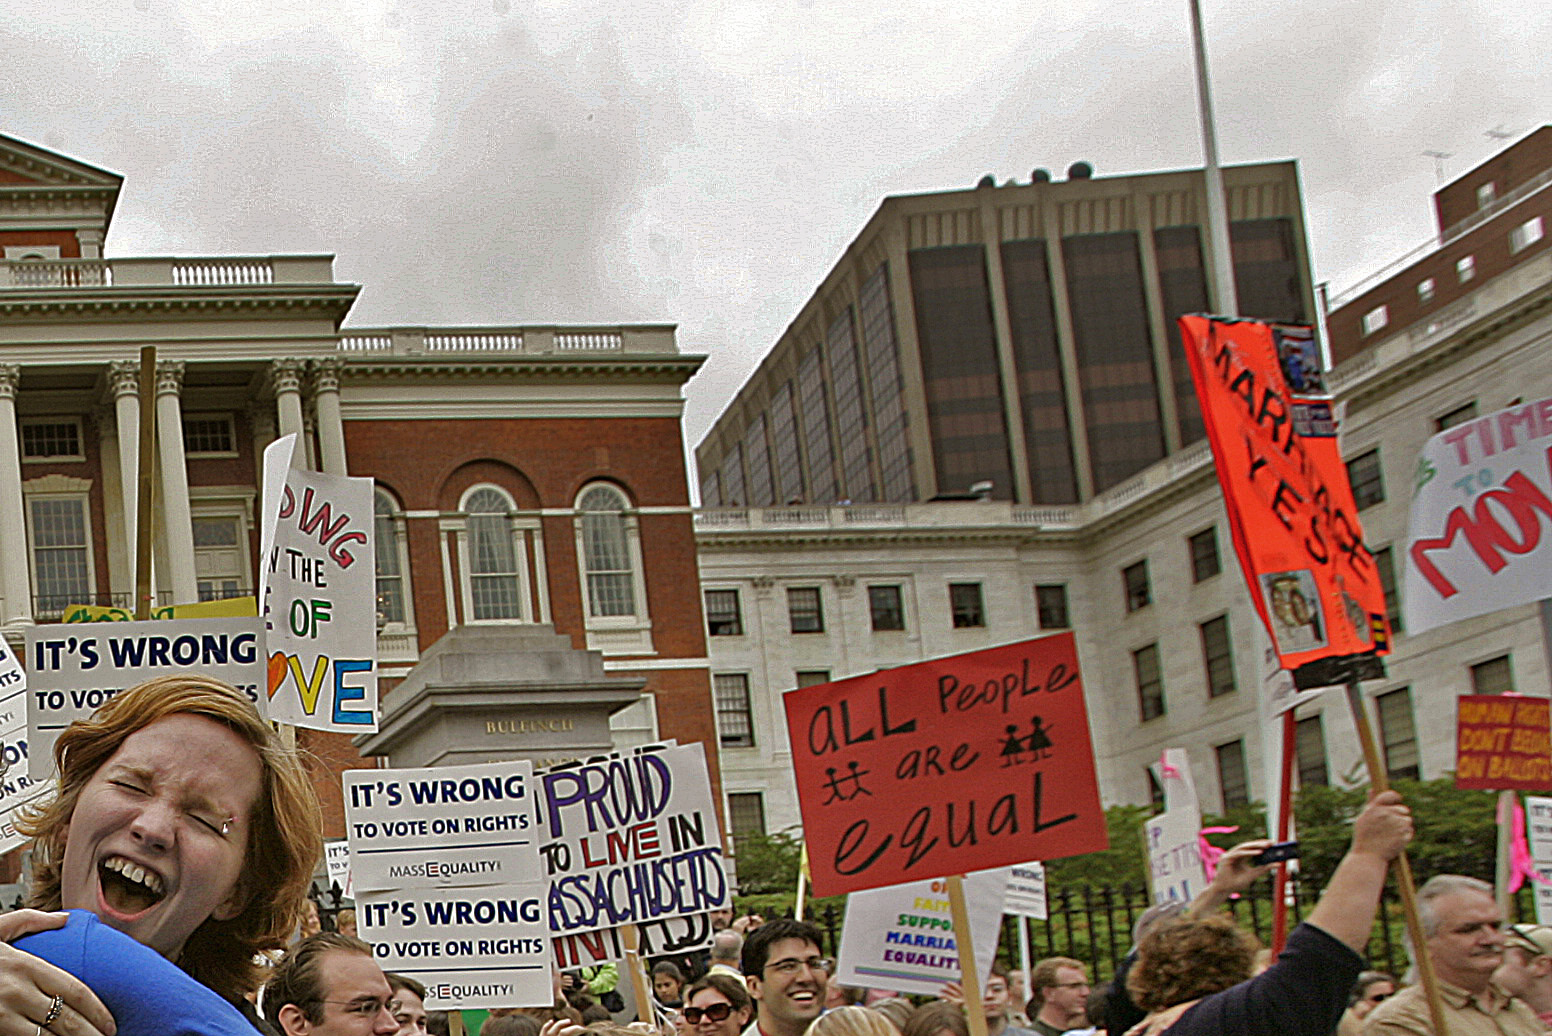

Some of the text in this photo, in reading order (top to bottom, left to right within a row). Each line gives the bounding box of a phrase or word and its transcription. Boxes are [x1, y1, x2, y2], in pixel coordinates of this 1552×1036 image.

[1453, 468, 1494, 497] TO
[286, 548, 327, 588] THE
[290, 599, 332, 639] OF
[36, 633, 256, 671] IT'S WRONG
[36, 692, 65, 710] TO
[485, 719, 574, 735] BULFINCH
[351, 775, 525, 808] IT'S WRONG
[543, 754, 671, 839] PROUD
[354, 814, 529, 838] TO VOTE ON RIGHTS
[539, 812, 704, 875] TO LIVE IN
[365, 899, 540, 927] IT'S WRONG
[897, 913, 953, 933] SUPPO
[395, 942, 440, 957] VOTE
[445, 941, 473, 956] ON
[479, 938, 544, 955] RIGHTS
